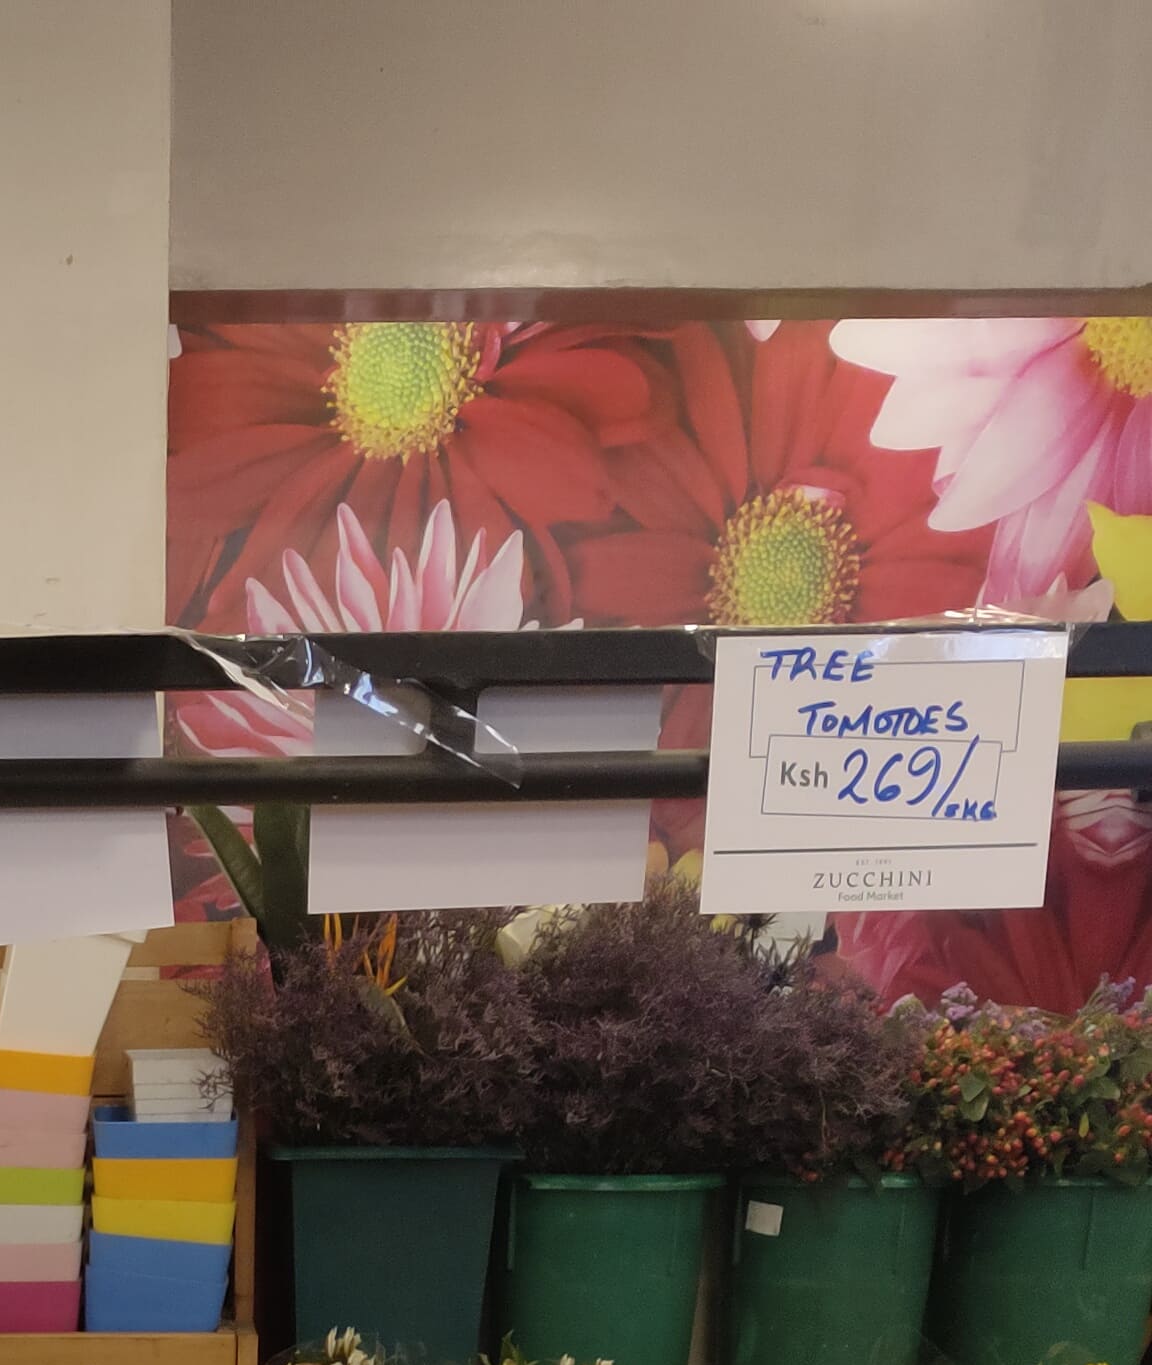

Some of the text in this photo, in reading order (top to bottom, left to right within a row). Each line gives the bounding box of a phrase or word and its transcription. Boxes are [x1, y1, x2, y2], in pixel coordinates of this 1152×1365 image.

[760, 647, 876, 682] TREE
[780, 761, 828, 788] Ksh
[812, 870, 933, 889] ZUCCHINI
[837, 890, 904, 903] Food Market
